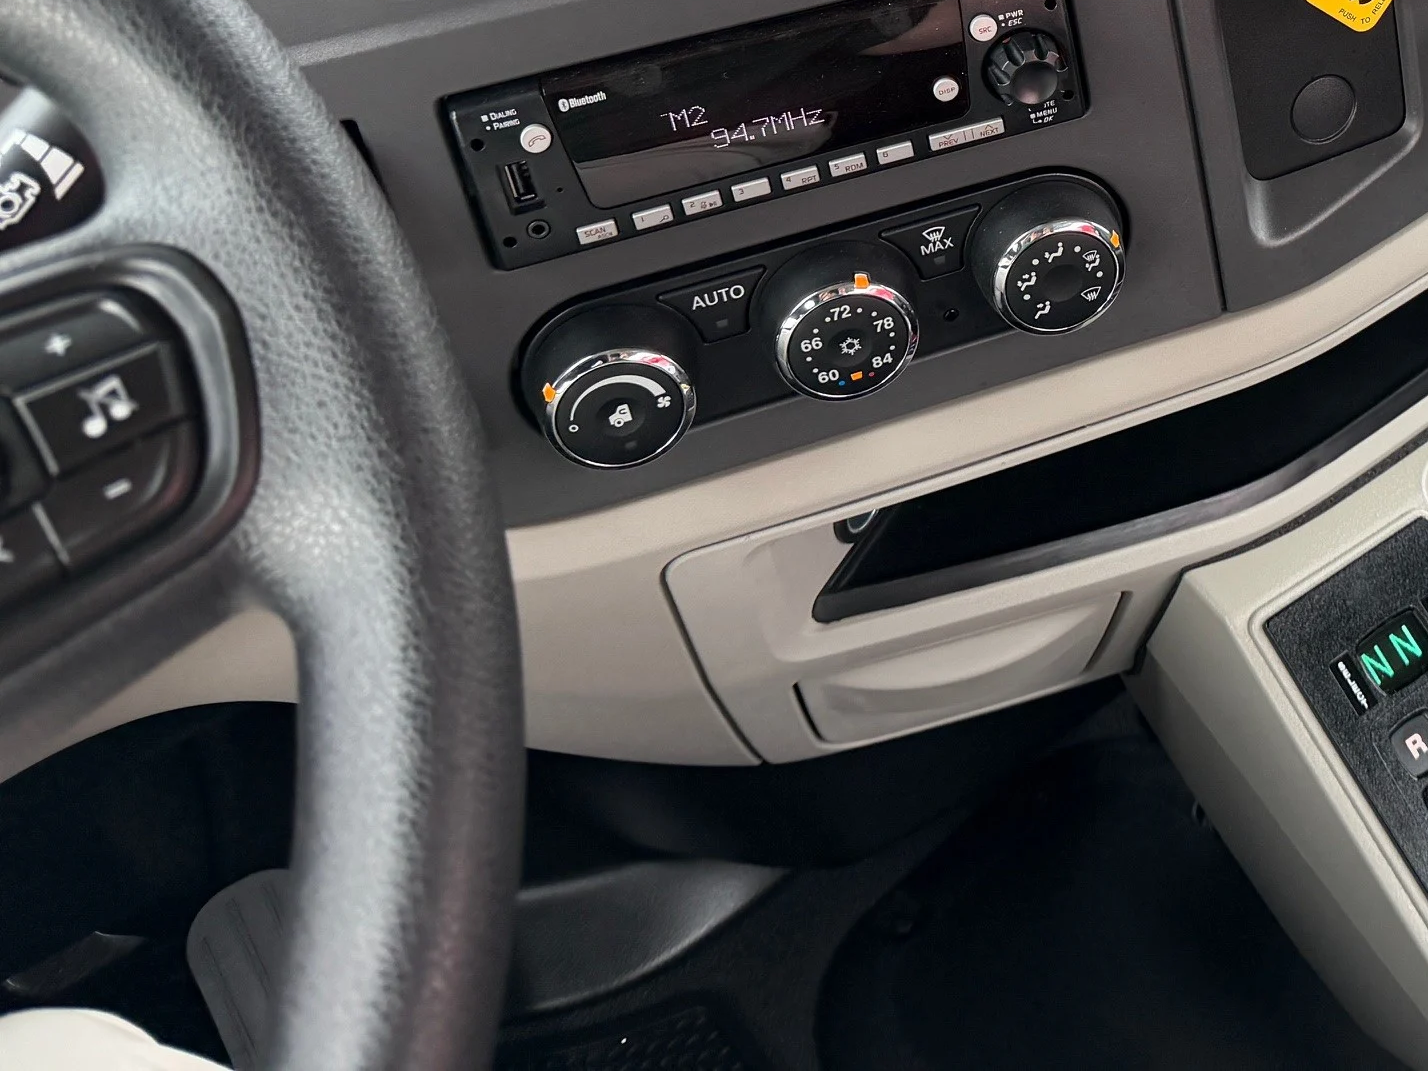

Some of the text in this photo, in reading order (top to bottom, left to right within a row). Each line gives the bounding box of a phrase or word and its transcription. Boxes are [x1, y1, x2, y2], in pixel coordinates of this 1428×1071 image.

[1005, 9, 1024, 19] PWR
[1338, 8, 1357, 22] PUSH
[1360, 16, 1371, 25] TO
[1008, 18, 1023, 27] ESC
[568, 90, 607, 109] Bluetooth
[1036, 107, 1058, 118] MENU
[710, 107, 825, 149] 94.7MHz
[980, 127, 999, 138] NEXT
[938, 138, 959, 148] PREV
[584, 227, 606, 238] SCAN
[920, 237, 954, 256] MAX
[691, 284, 745, 310] AUTO
[830, 305, 852, 322] 72
[873, 317, 895, 332] 78
[800, 337, 823, 353] 66
[871, 352, 893, 368] 84
[817, 369, 840, 384] 60
[1361, 624, 1422, 685] N N
[1405, 733, 1428, 760] R
